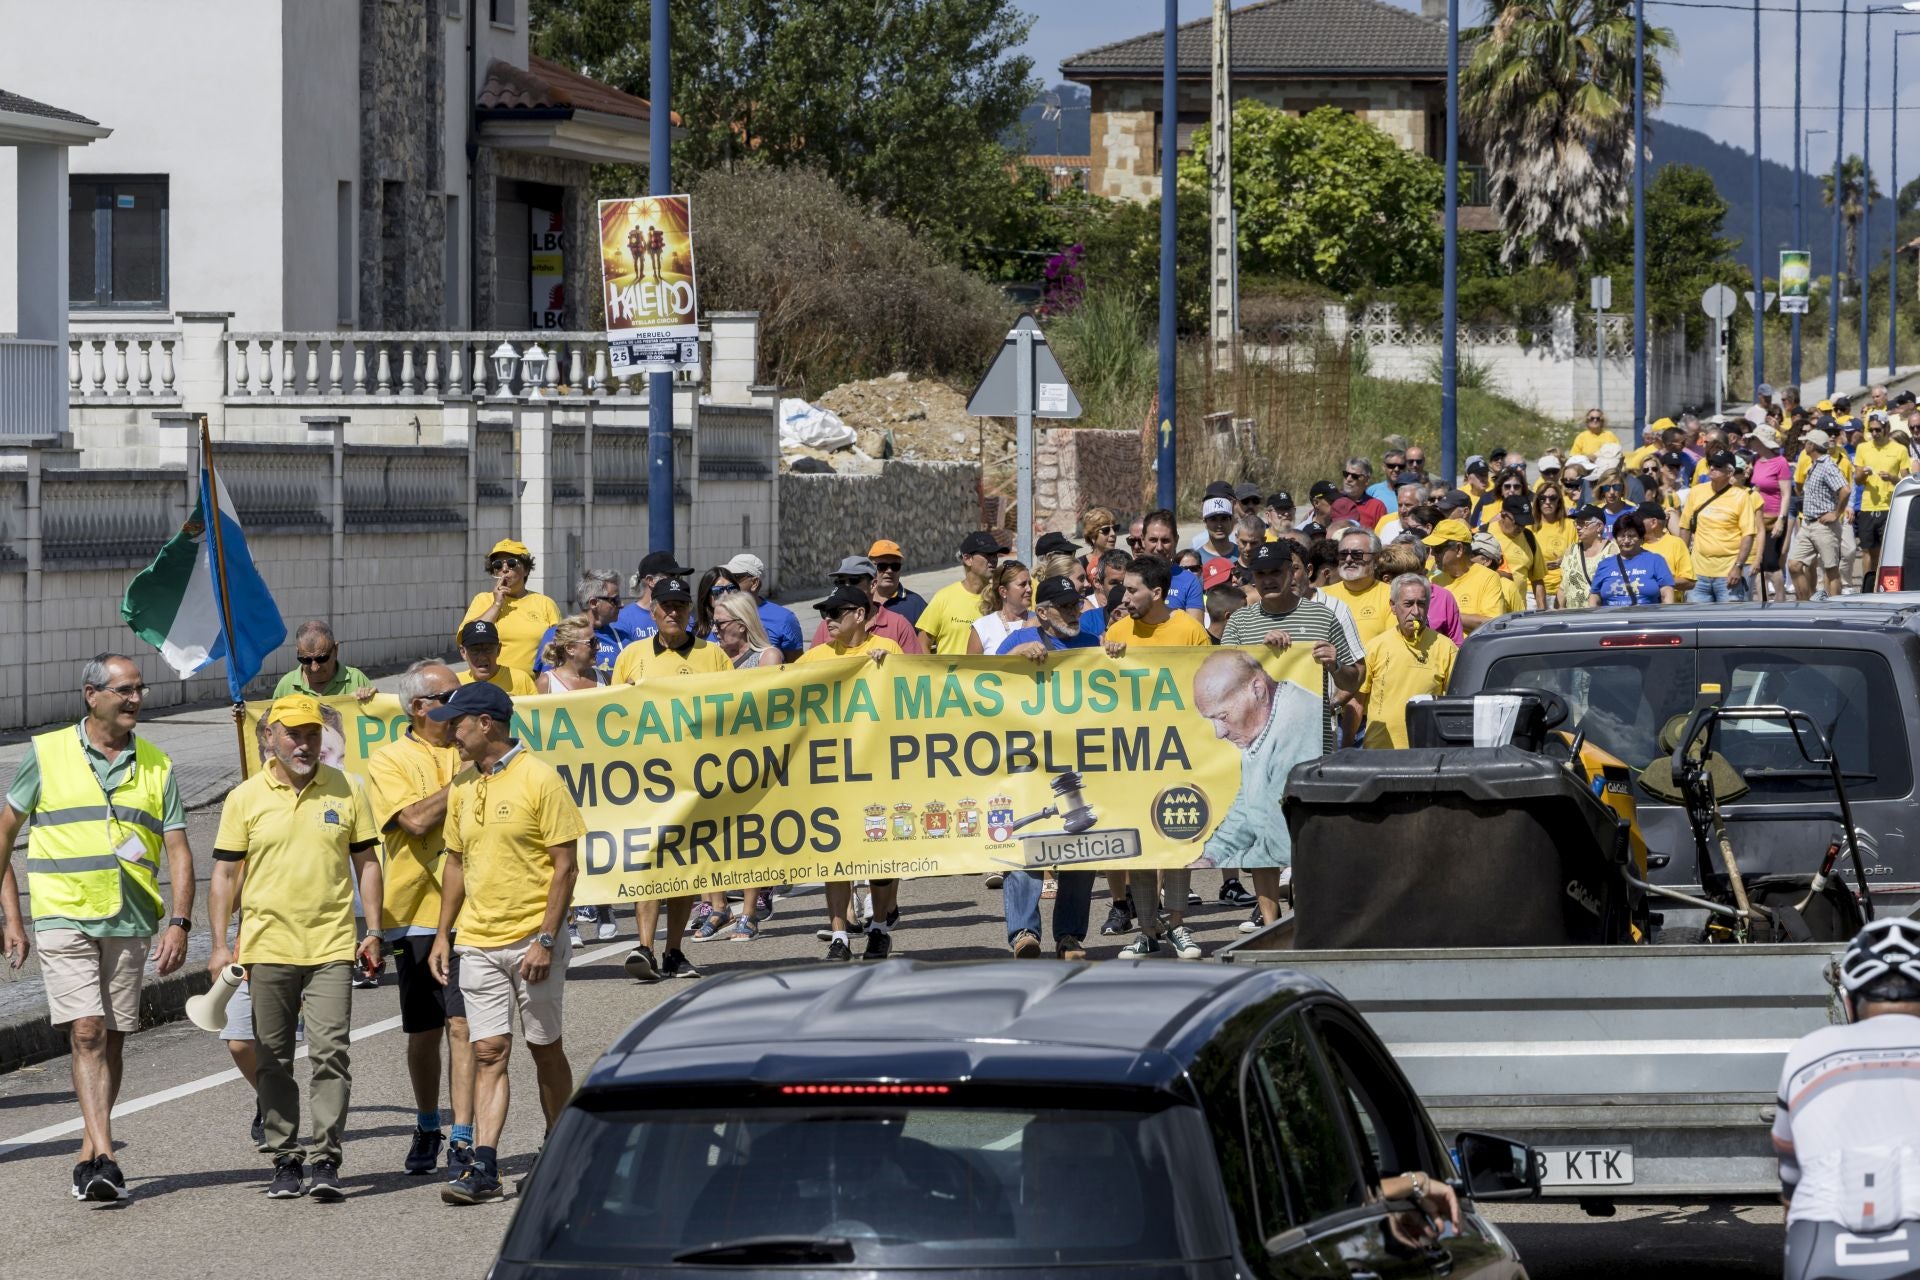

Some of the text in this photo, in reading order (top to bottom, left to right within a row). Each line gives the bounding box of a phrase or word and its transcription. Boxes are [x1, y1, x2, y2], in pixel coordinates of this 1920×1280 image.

[609, 280, 694, 323] KALEIDO
[612, 352, 627, 362] 25
[686, 348, 693, 357] 3
[636, 627, 646, 638] On
[596, 678, 881, 748] CANTABRIA
[894, 664, 1002, 721] MÁS
[1021, 666, 1185, 716] JUSTA
[693, 741, 791, 800] CON
[808, 737, 873, 785] EL
[890, 725, 1193, 781] PROBLEMA
[1164, 792, 1198, 805] AMA
[585, 806, 842, 876] DERRIBOS
[984, 842, 1016, 850] GOBIERNO
[1034, 834, 1126, 863] Justicia
[617, 857, 939, 898] Asociación de Maltratados por la Administración
[1566, 1150, 1624, 1180] KTK
